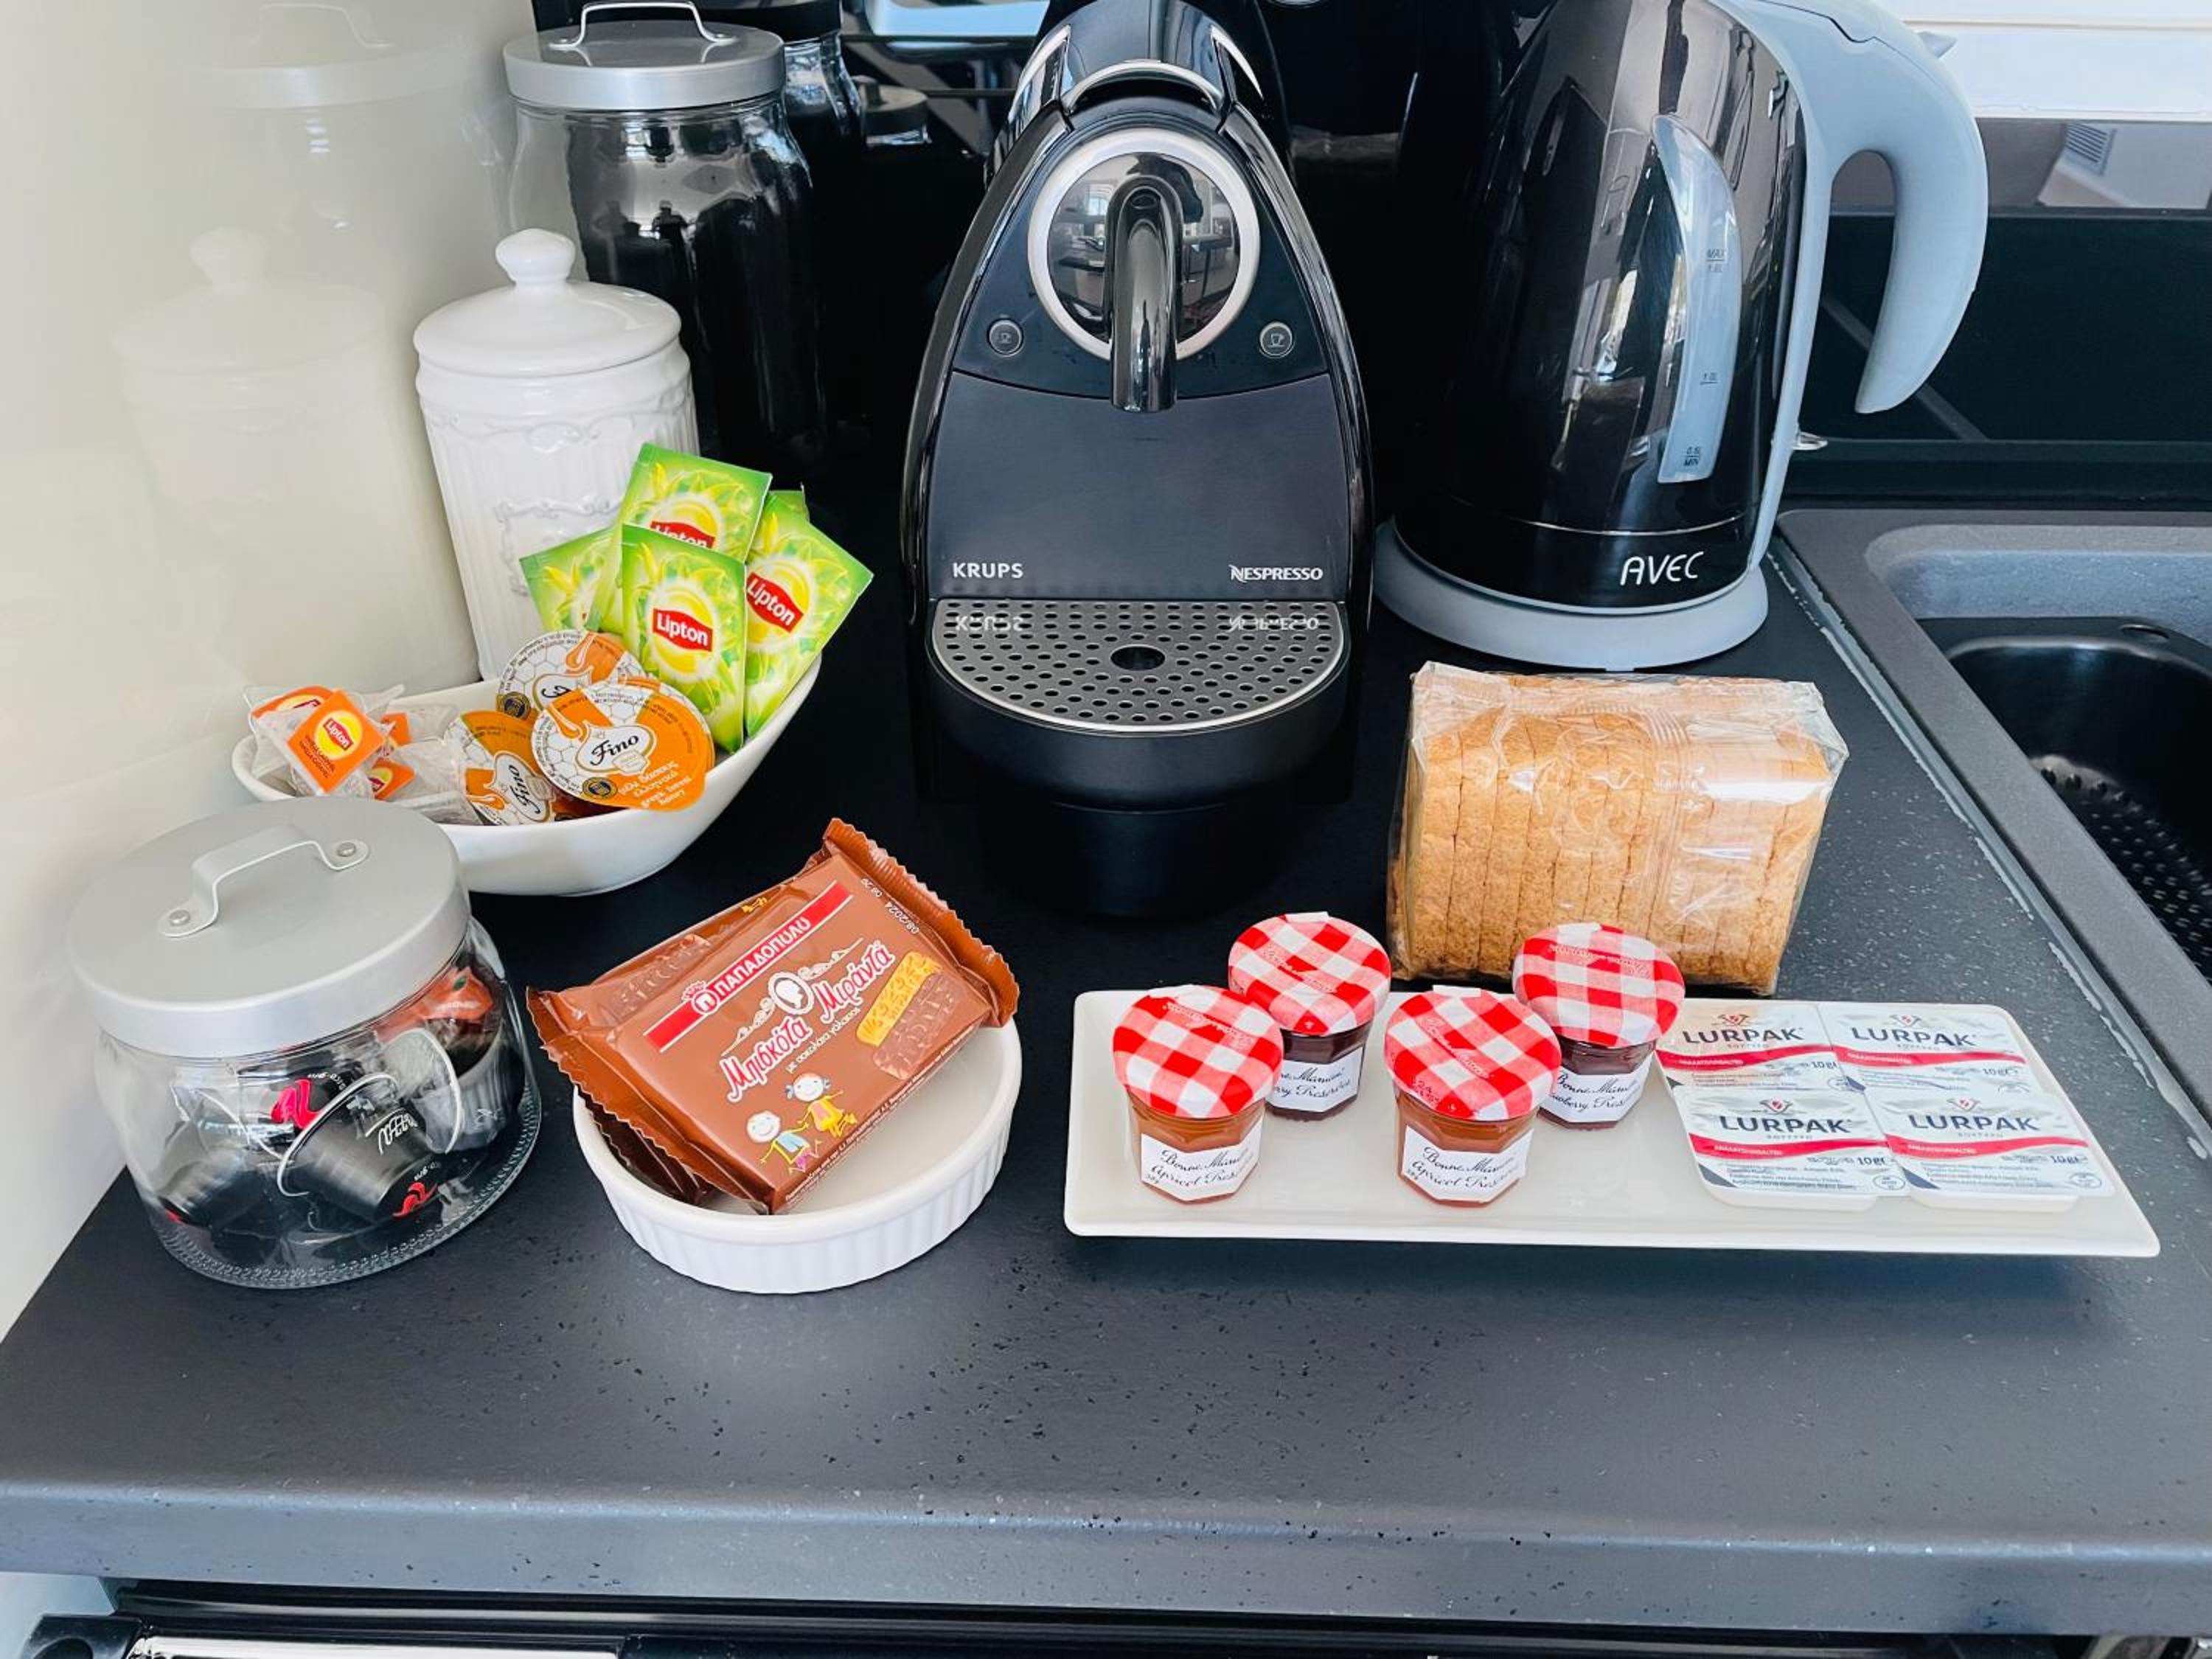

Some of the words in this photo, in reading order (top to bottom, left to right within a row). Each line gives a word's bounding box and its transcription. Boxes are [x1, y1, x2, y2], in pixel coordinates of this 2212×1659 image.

[952, 563, 1024, 579] KRUPS
[1229, 564, 1324, 582] NESPRESSO
[1620, 552, 1705, 586] AVEC
[747, 578, 794, 626] Lipton
[656, 613, 709, 647] Lipton
[327, 720, 352, 750] Lipton
[591, 732, 639, 767] Fino
[813, 944, 895, 1023] Μιράντα
[1682, 1027, 1806, 1044] LURPAK
[1851, 1026, 1978, 1047] LURPAK
[1719, 1115, 1851, 1134] LURPAK
[1907, 1114, 2041, 1131] LURPAK
[1161, 1149, 1202, 1172] Bonne
[1422, 1145, 1465, 1172] Bonne
[1151, 1164, 1202, 1188] Apricot
[1412, 1159, 1463, 1187] Apricot
